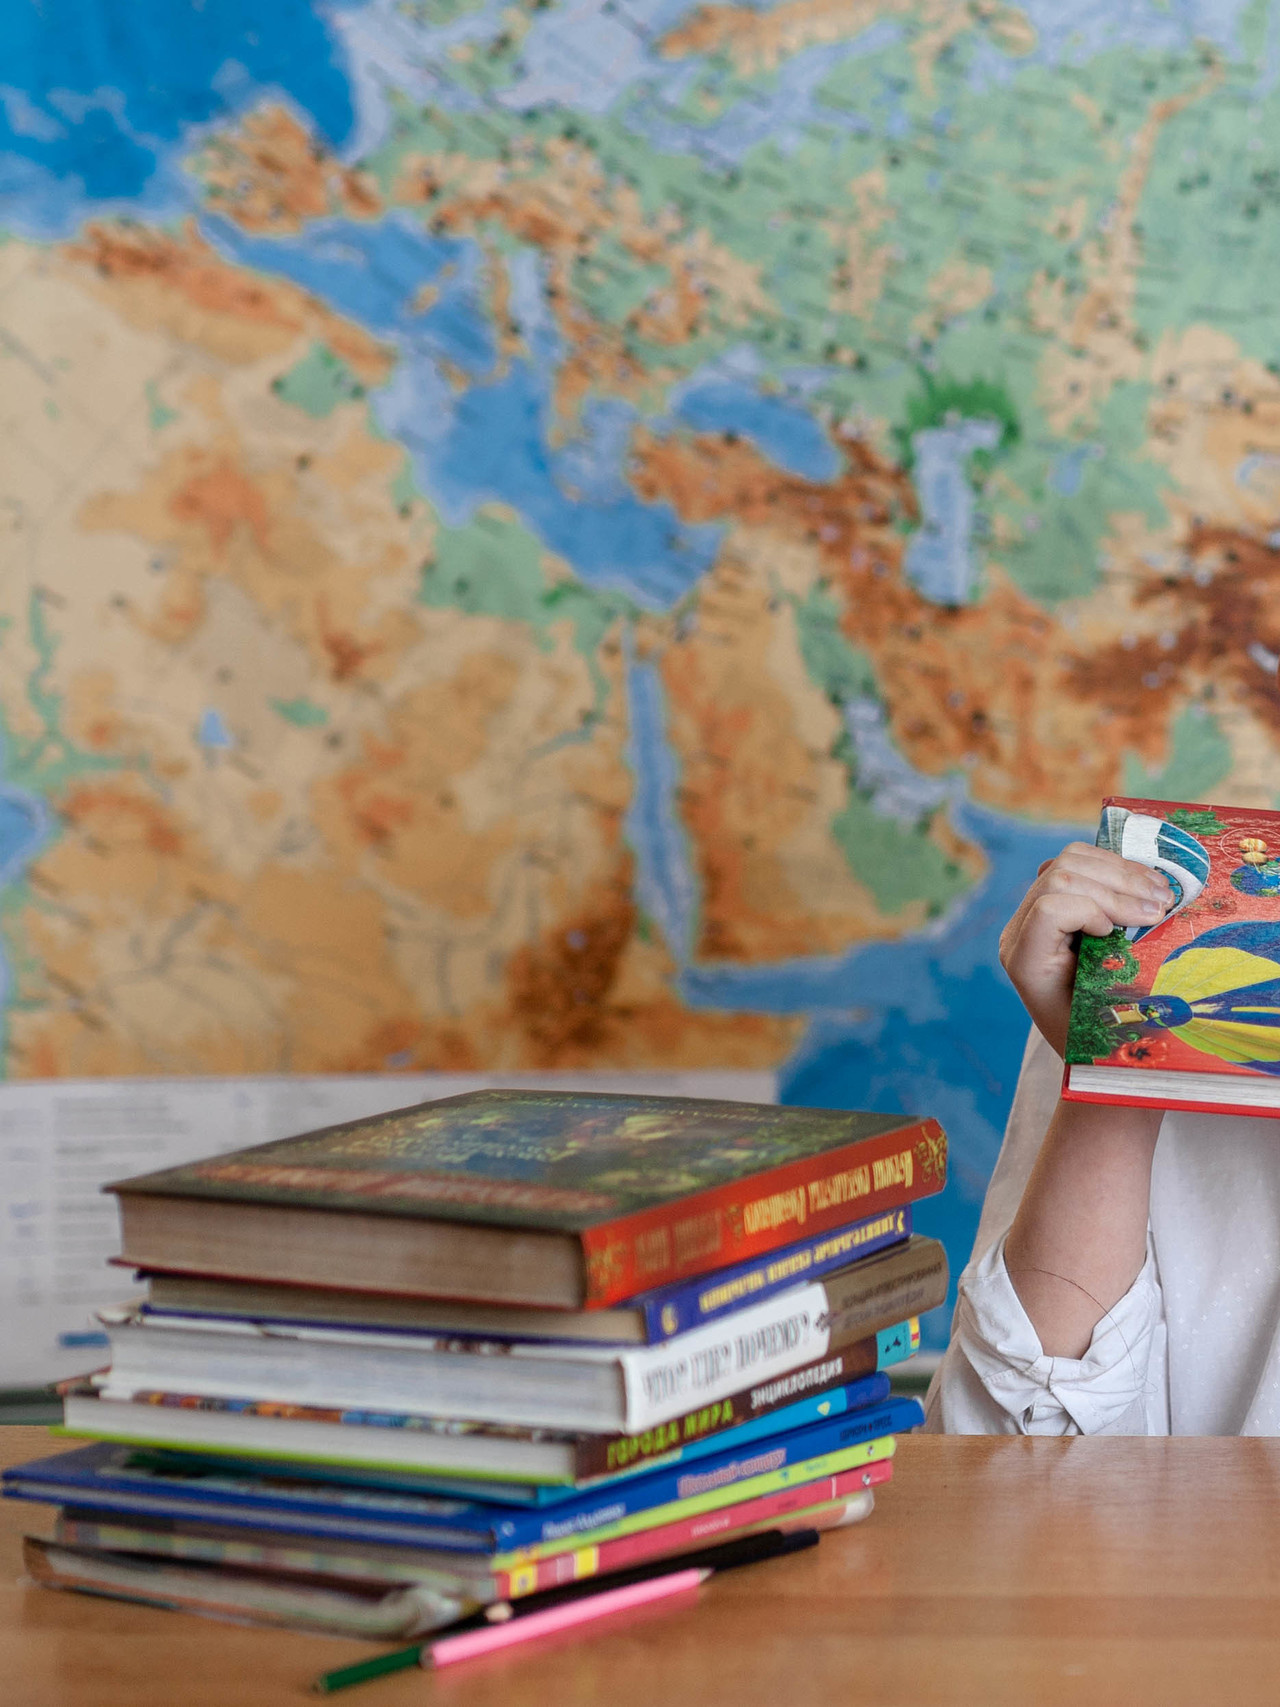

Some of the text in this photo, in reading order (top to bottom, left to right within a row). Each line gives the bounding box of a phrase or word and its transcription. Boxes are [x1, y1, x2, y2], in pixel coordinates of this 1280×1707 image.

[607, 1421, 680, 1469] ГОРОДА
[684, 1399, 734, 1439] МИРА
[751, 1357, 843, 1410] ЭНЦИКЛОПЕДИЯ
